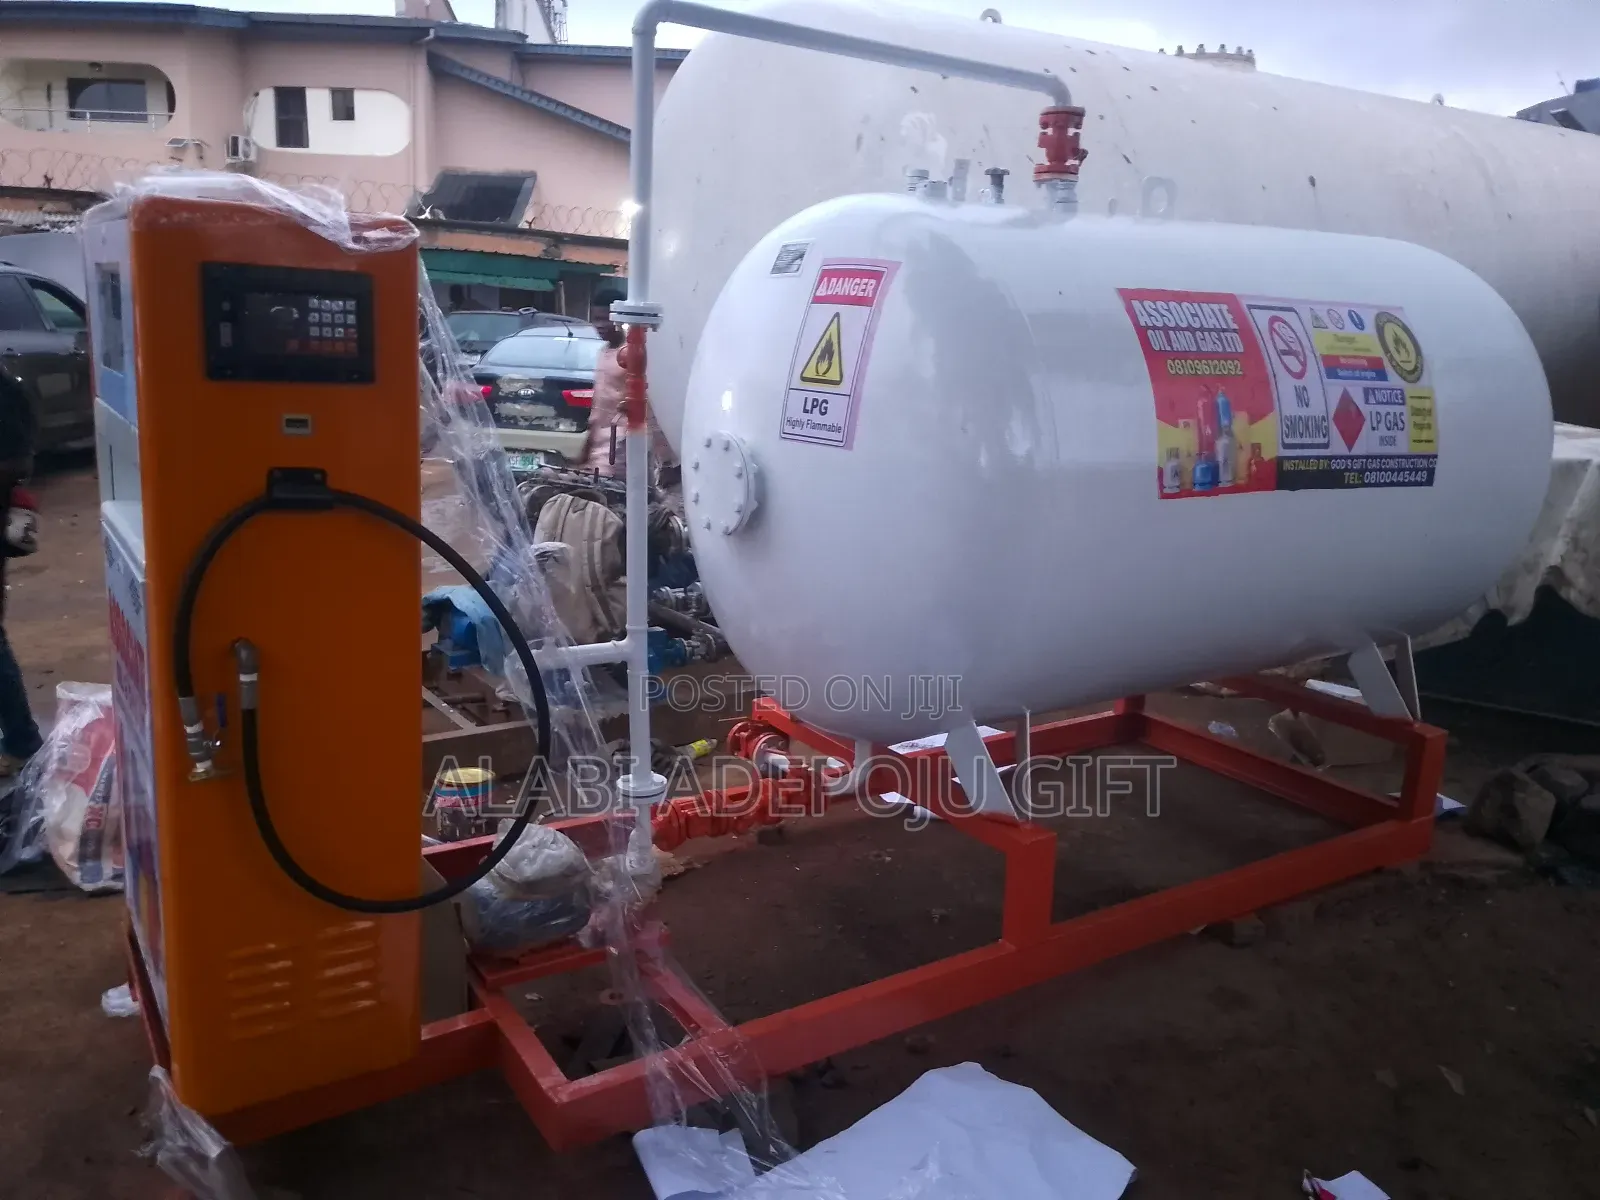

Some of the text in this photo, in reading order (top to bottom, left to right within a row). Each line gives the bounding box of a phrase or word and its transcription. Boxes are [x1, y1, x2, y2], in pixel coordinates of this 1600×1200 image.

[827, 277, 877, 298] DANGER
[1130, 299, 1239, 330] ASSOCIATE
[1146, 329, 1244, 352] OIL AND GAS LTD
[1166, 358, 1243, 375] 08109612092
[1294, 384, 1310, 409] NO
[1374, 389, 1403, 401] NOTICE
[802, 396, 829, 416] LPG
[786, 417, 842, 434] Highly Flammable
[1283, 414, 1329, 439] SMOKING
[1369, 410, 1382, 431] LP
[1384, 411, 1405, 432] GAS
[1379, 434, 1397, 447] INSIDE
[1283, 459, 1318, 471] INSTALLED
[1330, 459, 1352, 470] GOD'S
[1352, 459, 1366, 469] GIFT
[1367, 459, 1380, 469] GAS
[1381, 459, 1428, 469] CONSTRUCTION
[1344, 470, 1427, 484] TEL: 08100445449
